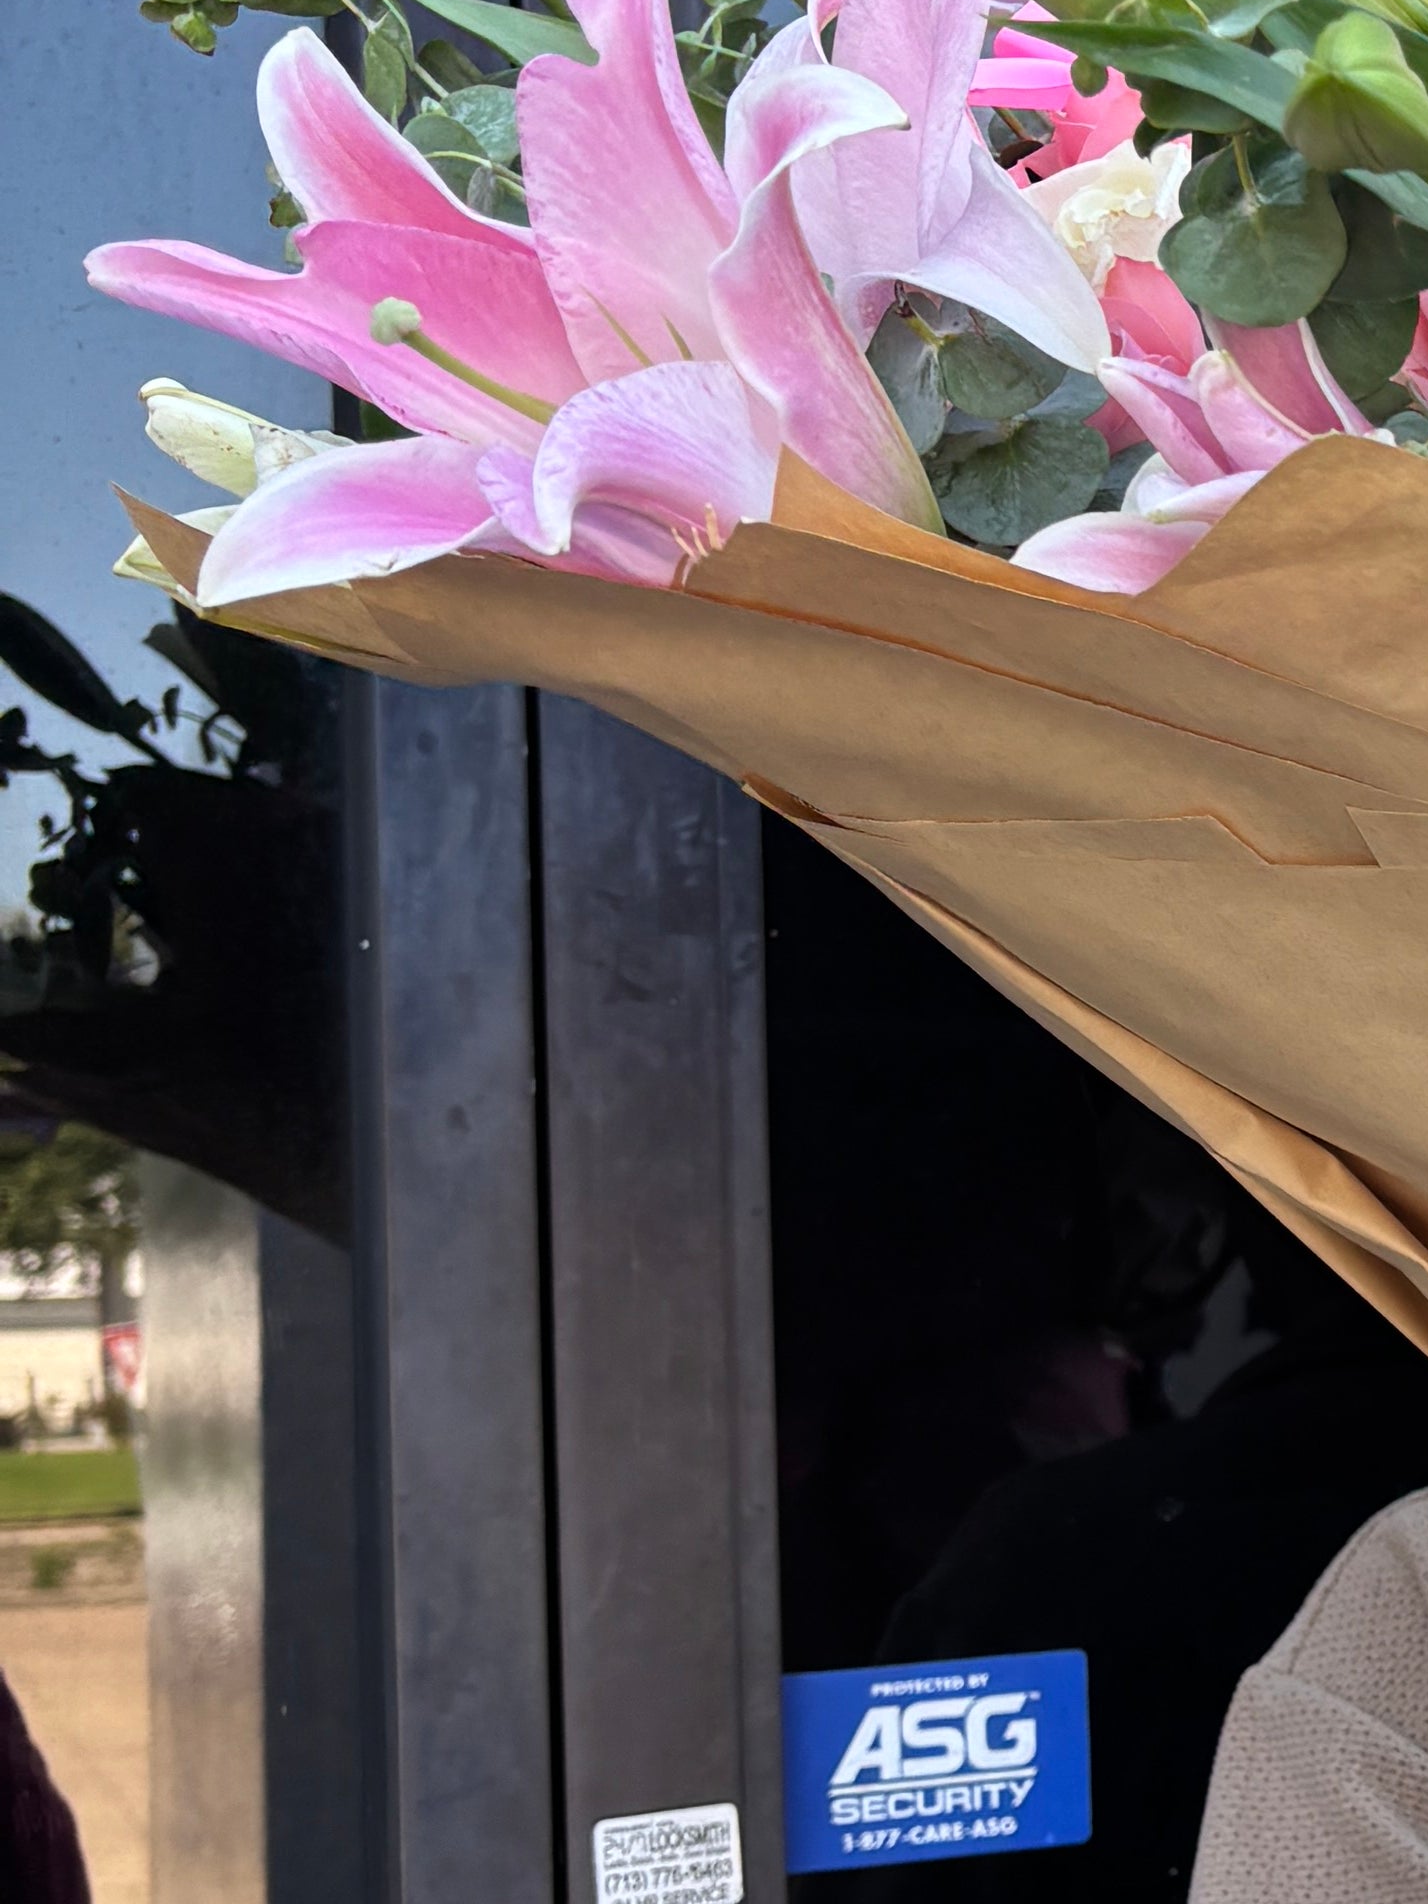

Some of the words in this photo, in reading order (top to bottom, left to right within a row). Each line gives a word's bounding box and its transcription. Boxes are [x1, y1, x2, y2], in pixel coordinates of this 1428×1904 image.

[870, 1675, 964, 1696] PROTECTED
[967, 1673, 989, 1689] BY
[829, 1692, 1038, 1785] ASG
[830, 1779, 1035, 1826] SECURITY
[842, 1816, 1018, 1853] 1-877-CARE-ASG
